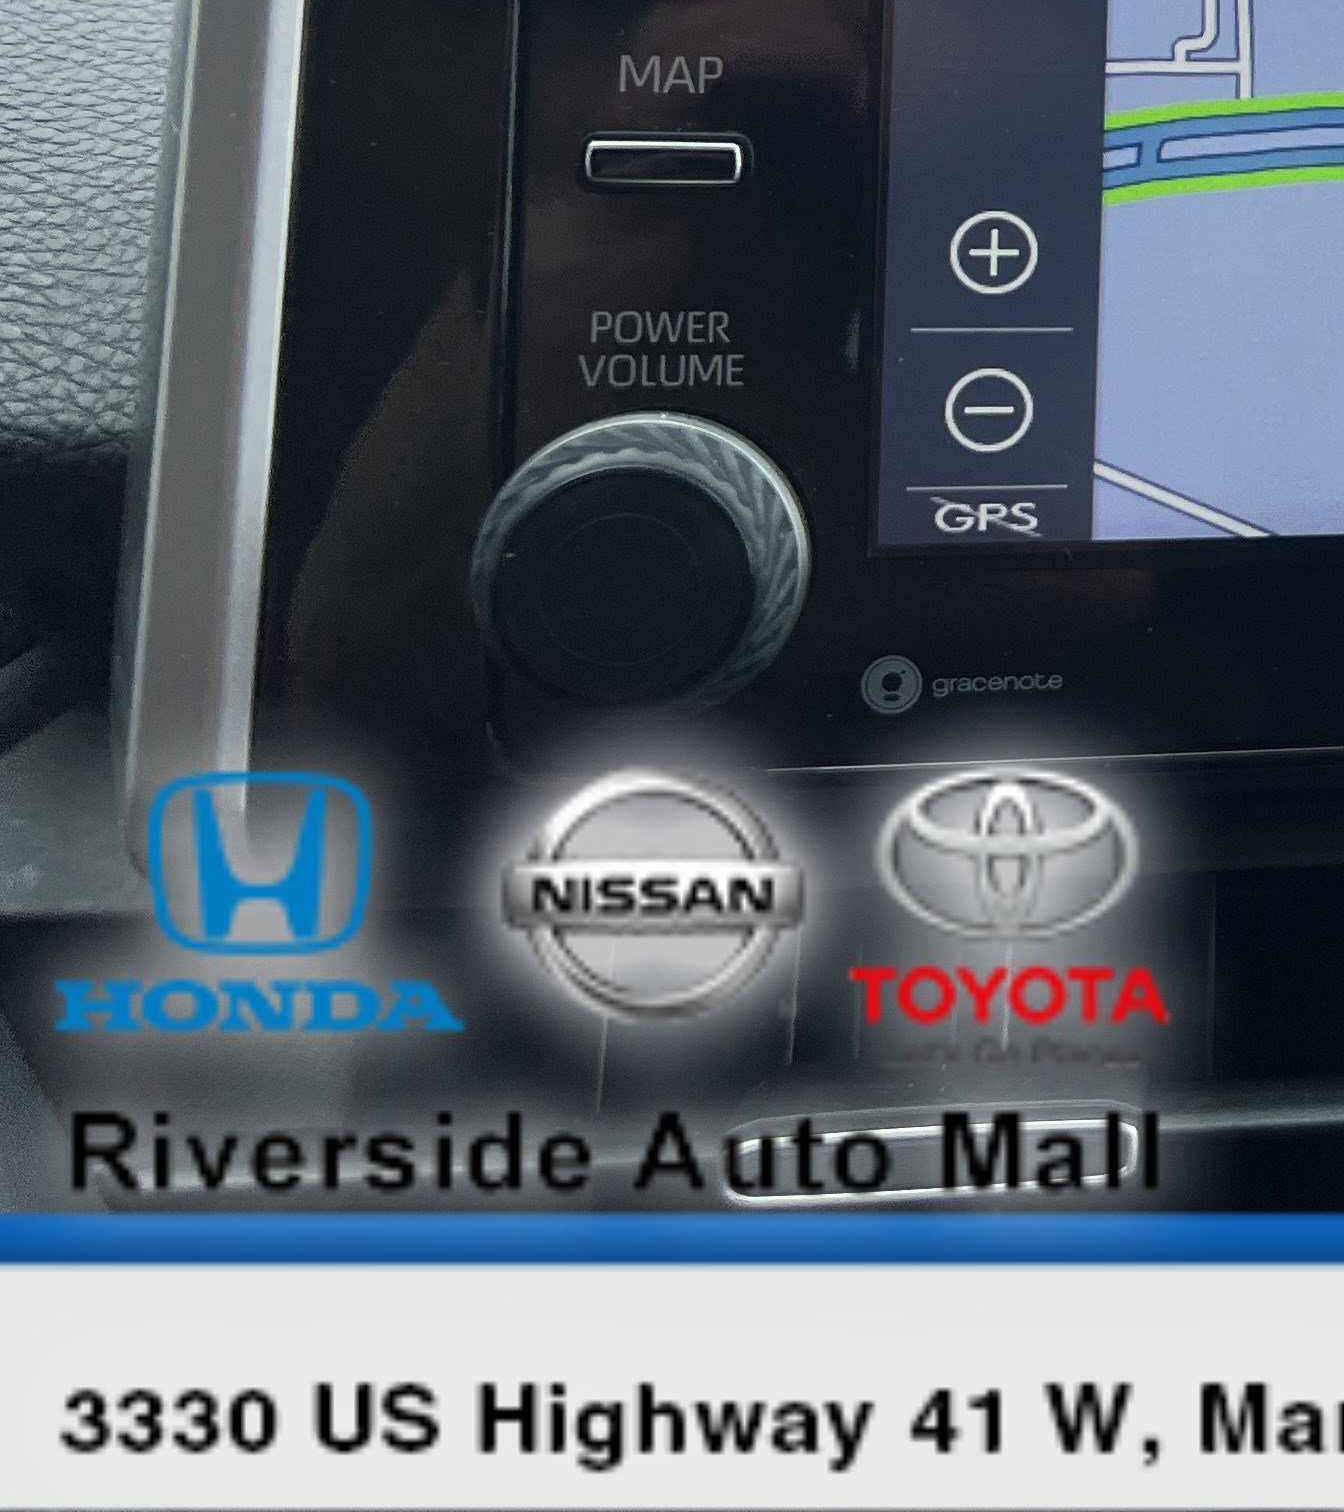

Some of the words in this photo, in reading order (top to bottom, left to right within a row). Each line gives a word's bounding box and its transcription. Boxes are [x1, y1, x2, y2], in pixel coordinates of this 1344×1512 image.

[618, 53, 724, 95] MAP
[589, 309, 731, 344] POWER
[577, 353, 746, 388] VOLUME
[933, 501, 1039, 534] GPS
[931, 673, 1064, 698] gracenote
